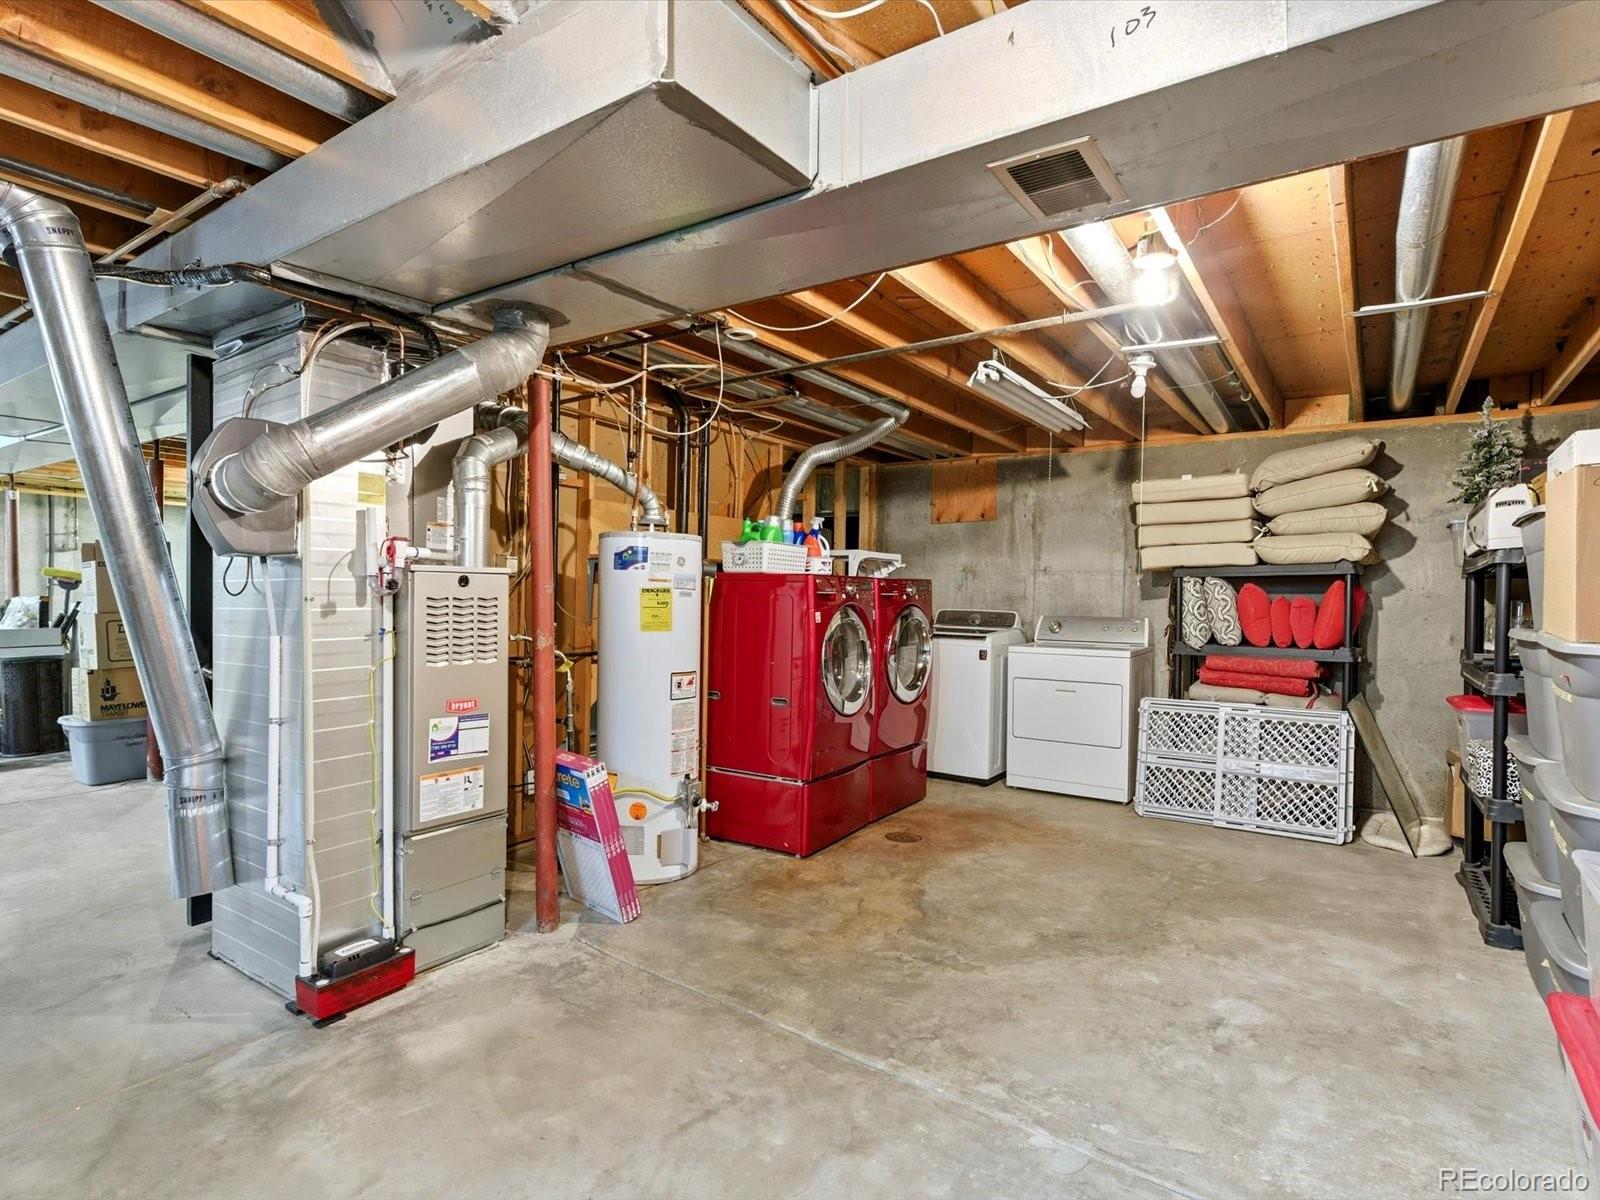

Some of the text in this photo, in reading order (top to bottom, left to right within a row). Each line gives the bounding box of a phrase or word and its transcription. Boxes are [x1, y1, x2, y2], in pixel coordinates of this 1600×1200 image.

[1110, 5, 1157, 48] 103
[100, 701, 148, 712] MAYFLOWE
[557, 772, 580, 789] rete
